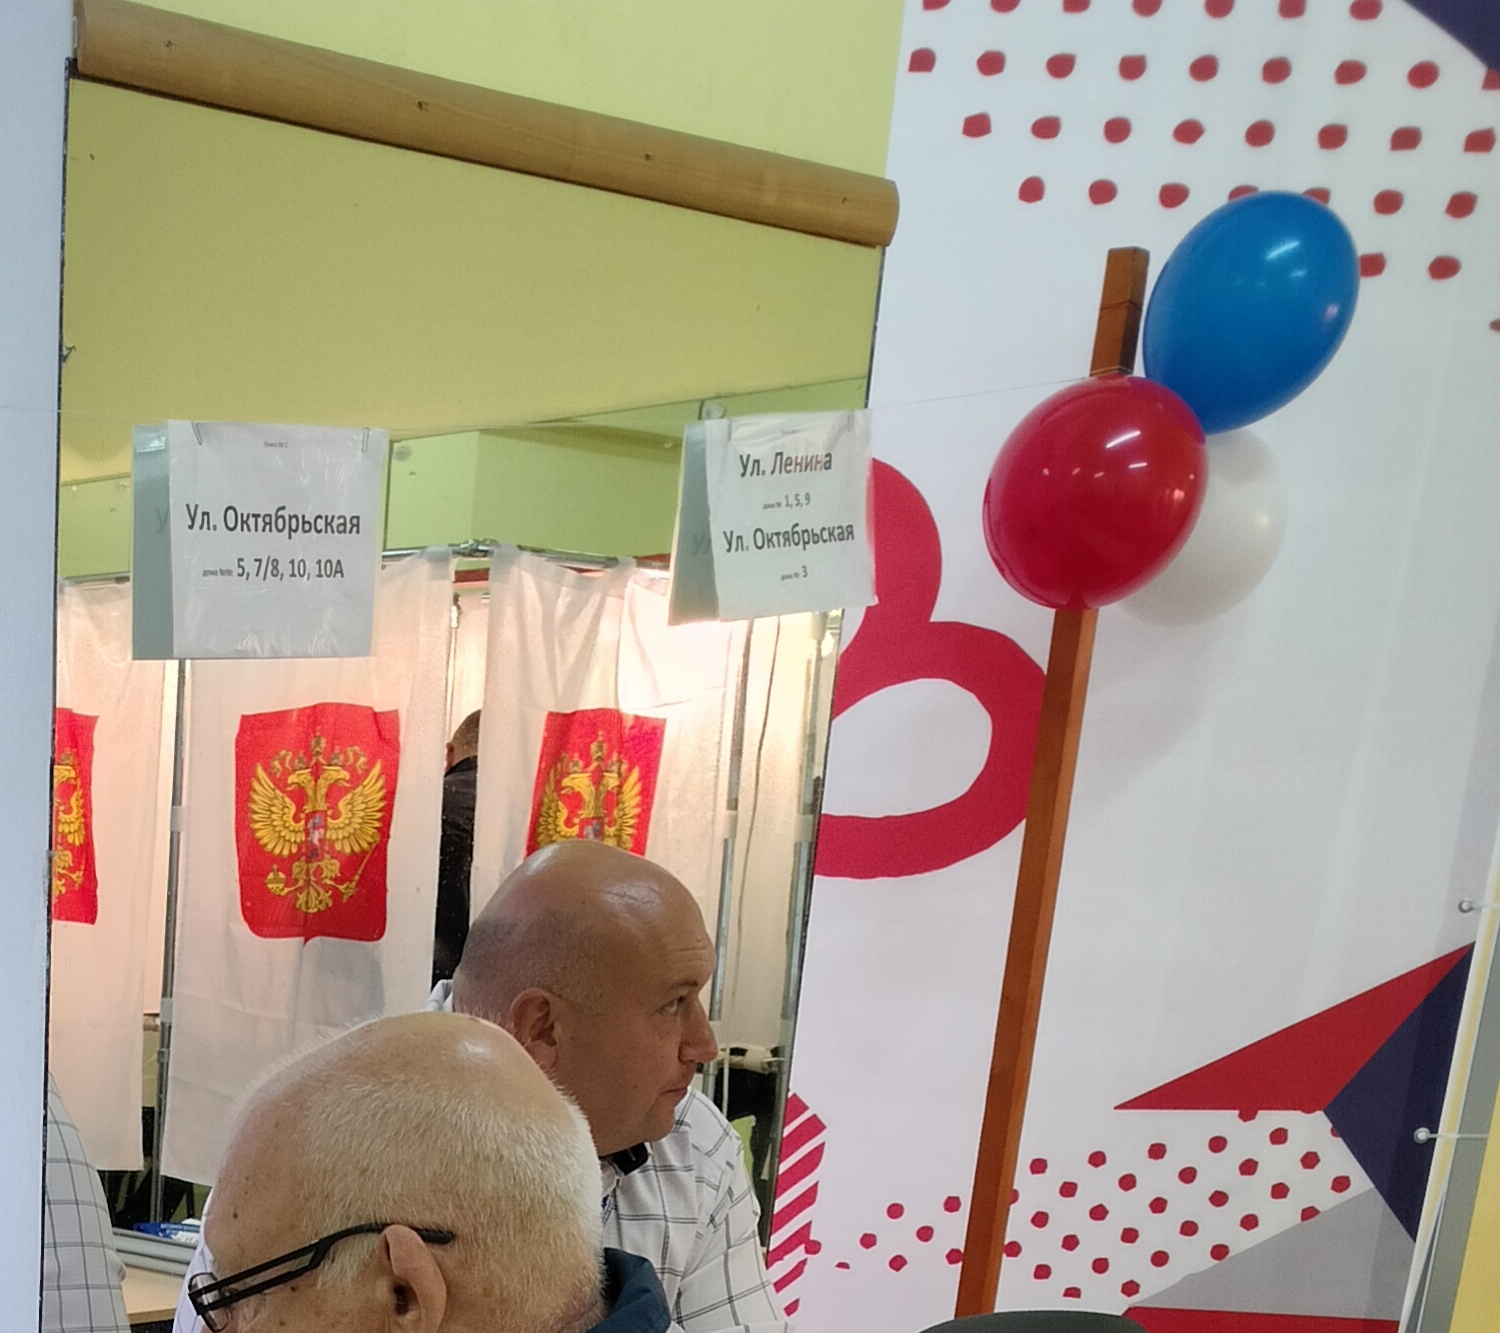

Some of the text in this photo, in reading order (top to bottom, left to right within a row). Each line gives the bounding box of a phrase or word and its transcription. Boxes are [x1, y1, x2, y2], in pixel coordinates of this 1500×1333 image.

[739, 451, 832, 478] Ул. Ленина
[804, 492, 811, 506] 9
[185, 503, 218, 531] Ул.
[223, 505, 361, 540] Октябрьская
[722, 530, 750, 553] Ул.
[753, 522, 855, 551] Октябрьская
[237, 557, 250, 581] 5,
[253, 555, 284, 581] 7/8,
[288, 558, 311, 581] 10,
[315, 558, 345, 578] 10А
[801, 565, 808, 578] 3
